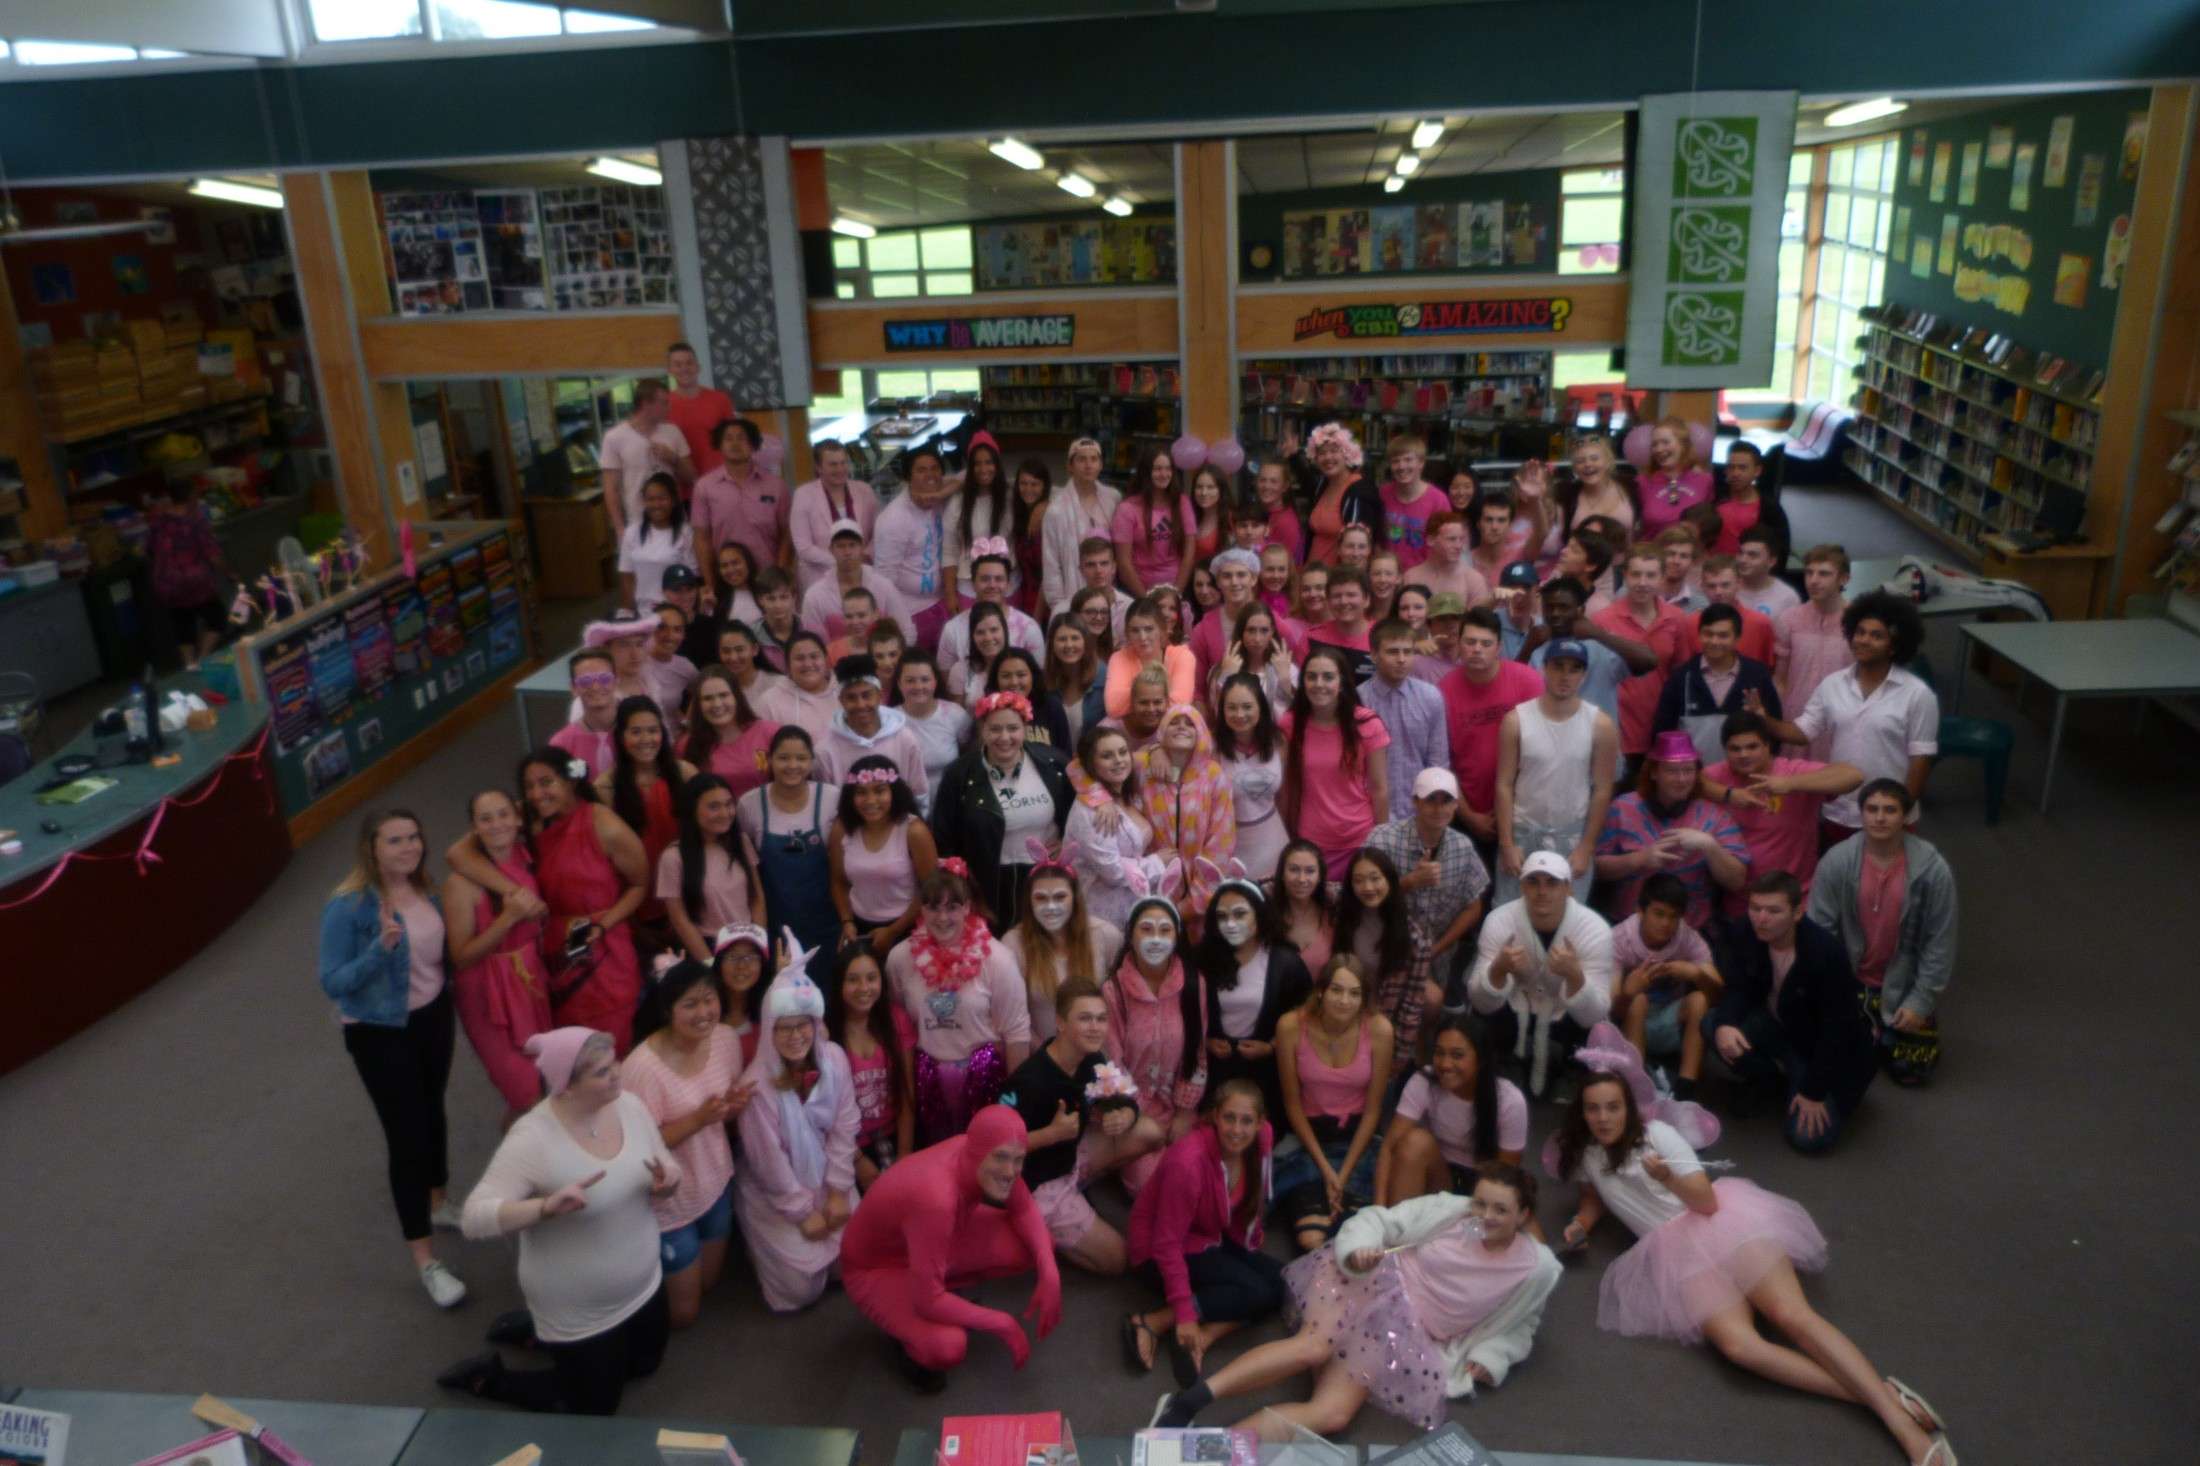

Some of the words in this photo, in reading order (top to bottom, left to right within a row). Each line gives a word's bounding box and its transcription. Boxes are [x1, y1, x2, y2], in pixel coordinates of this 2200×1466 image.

[1295, 307, 1347, 333] when
[1349, 306, 1393, 324] you
[1353, 320, 1397, 336] can
[1420, 299, 1570, 331] AMAZING?
[889, 325, 945, 346] WHY
[976, 318, 1070, 347] AVERAGE
[0, 1411, 49, 1437] AKING
